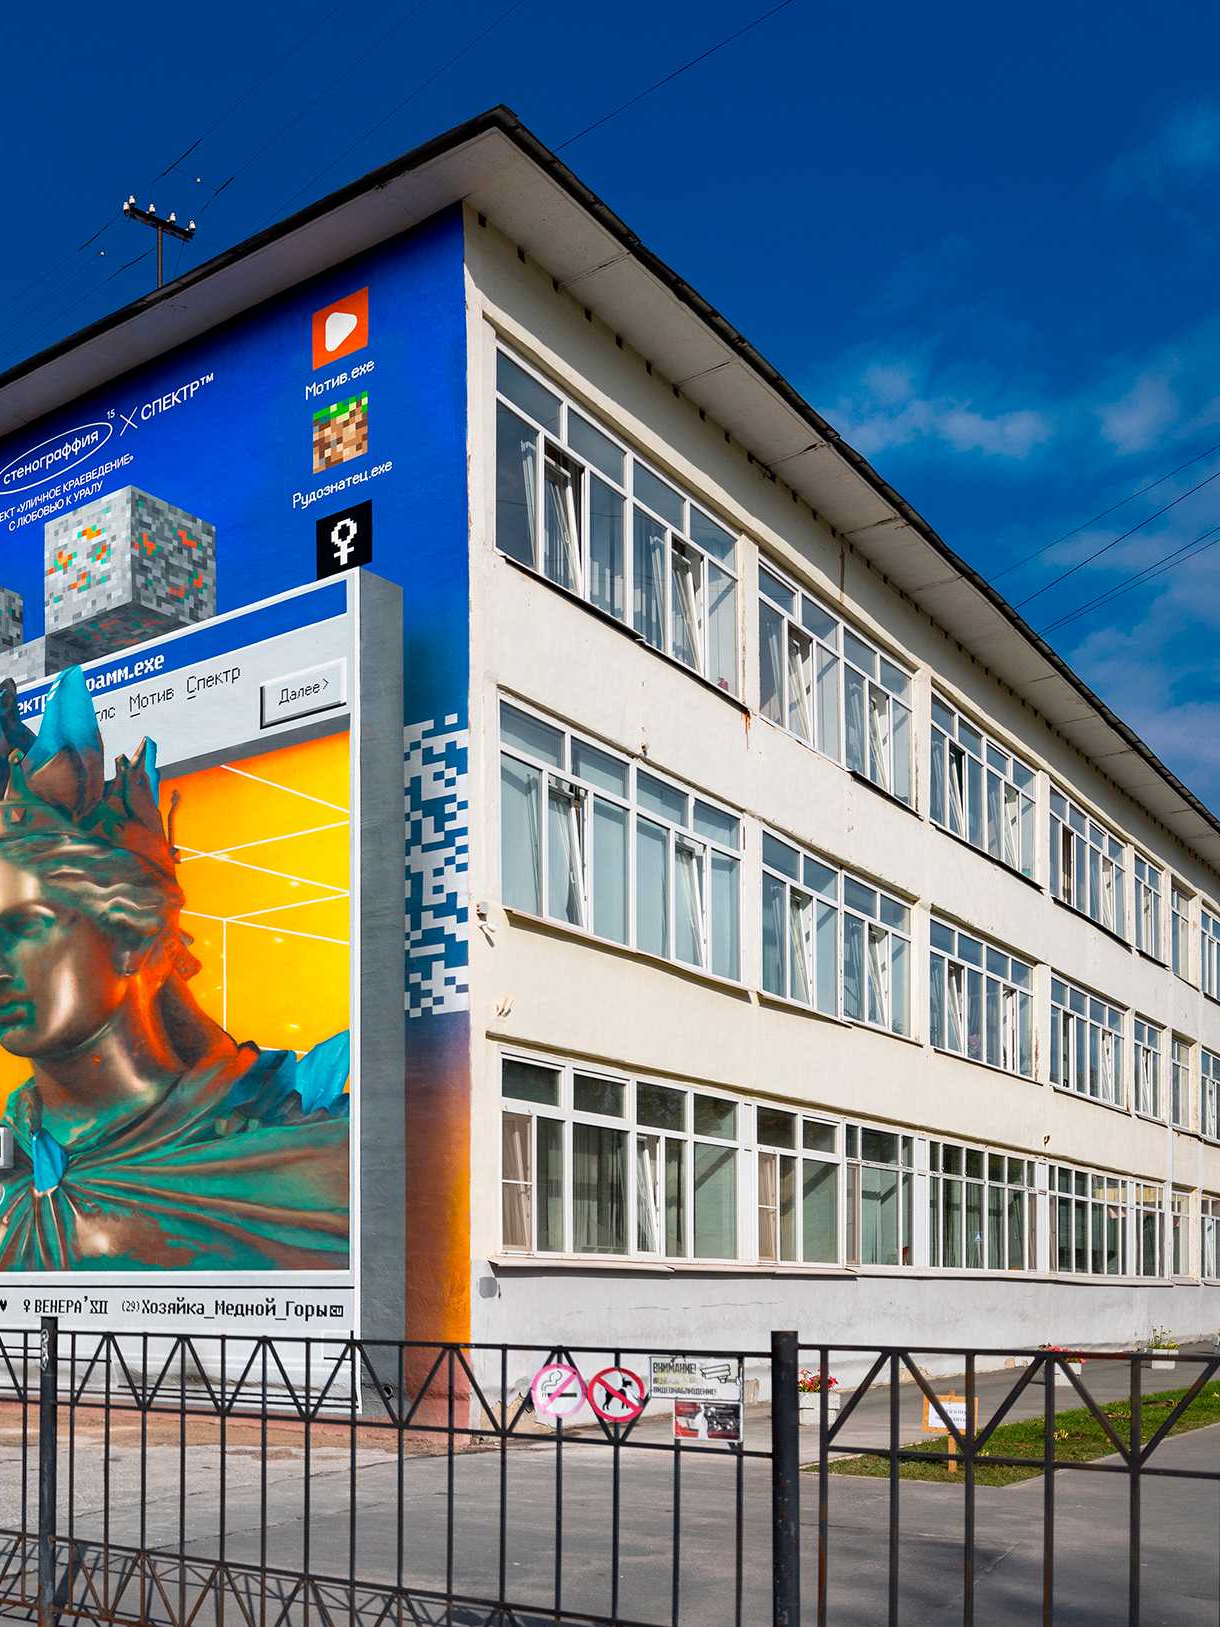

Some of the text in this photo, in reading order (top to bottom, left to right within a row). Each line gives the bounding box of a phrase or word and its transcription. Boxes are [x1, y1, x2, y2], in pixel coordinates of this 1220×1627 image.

[305, 359, 375, 401] Мотив.exe
[3, 430, 99, 485] стенограффия
[63, 453, 134, 493] КРАЕВЕДЕНИЕ»
[8, 480, 103, 532] С ЛЮБОВЬЮ К УРАЛУ
[292, 460, 393, 510] Рудознатец.exe
[86, 655, 165, 692] рамм.exe
[130, 687, 174, 715] Мотив
[187, 667, 241, 697] Спектр
